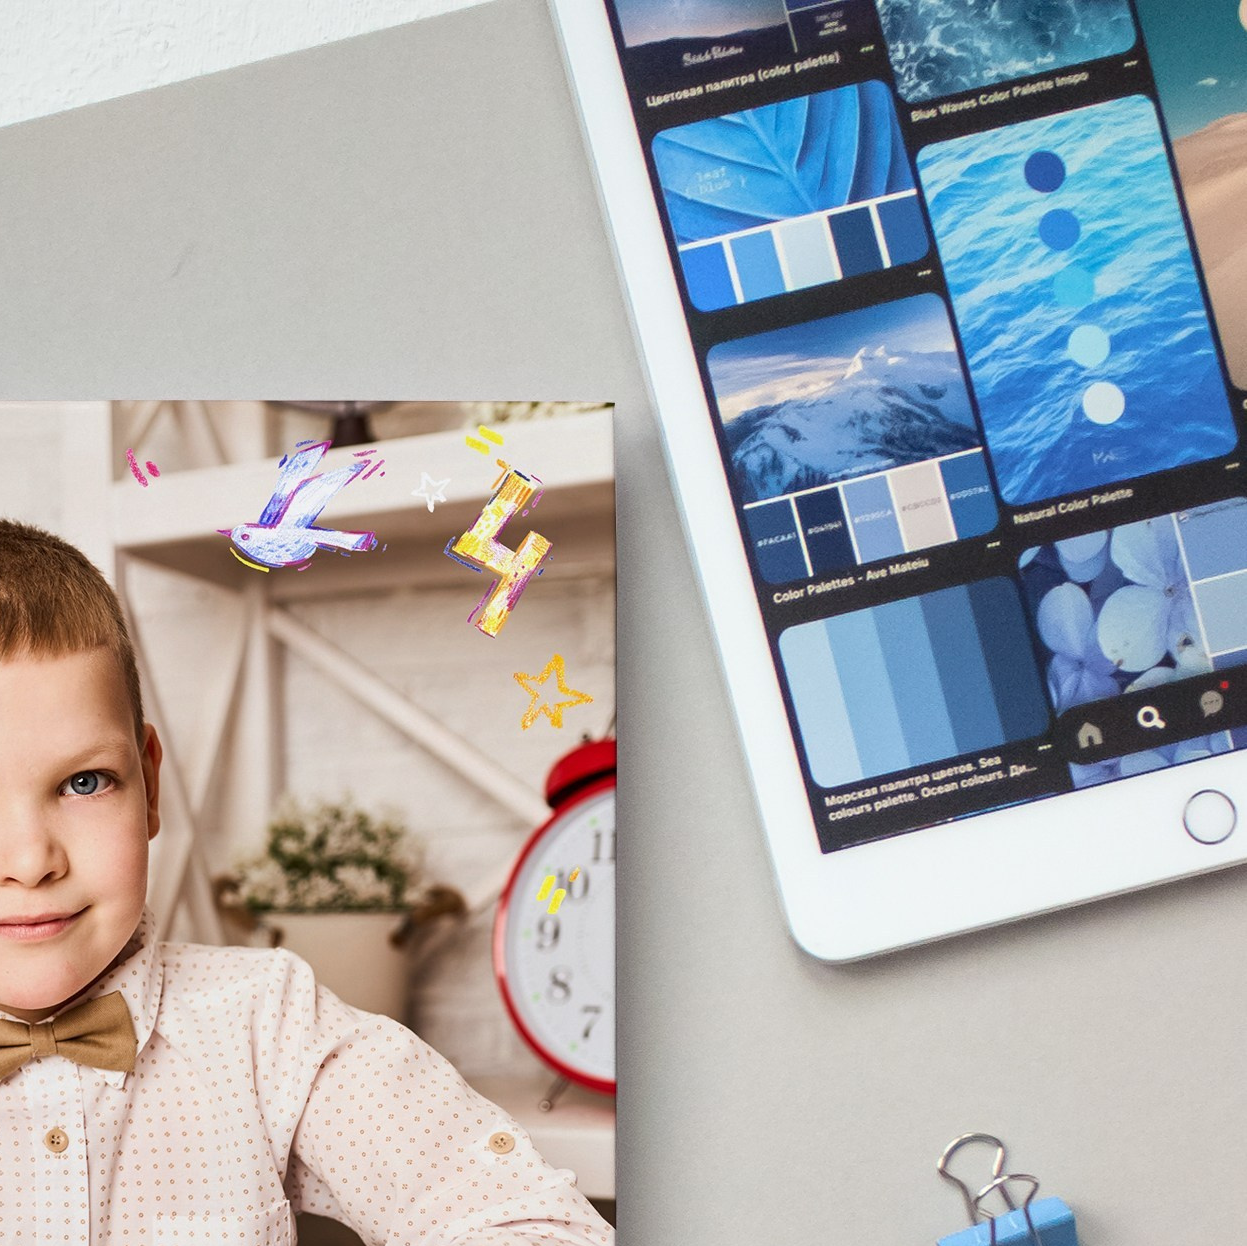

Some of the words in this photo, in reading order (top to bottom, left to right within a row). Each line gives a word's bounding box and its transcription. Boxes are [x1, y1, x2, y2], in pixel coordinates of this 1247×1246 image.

[645, 85, 704, 108] Цветовая
[705, 73, 756, 93] палитра
[757, 64, 792, 82] (color
[793, 51, 841, 74] palette)
[910, 108, 938, 123] Blue
[938, 98, 978, 115] Waves
[978, 89, 1011, 106] Color
[1011, 79, 1054, 98] Palette
[1054, 71, 1089, 87] Inspo
[1013, 505, 1057, 525] Natural
[1057, 498, 1090, 514] Color
[1091, 488, 1134, 506] Palette
[448, 469, 554, 640] 4
[772, 588, 805, 604] Color
[806, 576, 856, 596] Palettes
[865, 568, 888, 581] Ave
[888, 557, 930, 575] Mateiu
[824, 786, 879, 807] Морская
[879, 773, 930, 793] палитра
[931, 762, 977, 781] цветов.
[978, 755, 1002, 769] Sea
[828, 803, 873, 822] colours
[873, 792, 919, 812] palette.
[920, 781, 959, 798] Ocean
[959, 770, 1008, 788] colours.
[536, 914, 561, 951] 9
[547, 966, 573, 1005] 8
[581, 1005, 603, 1040] 7
